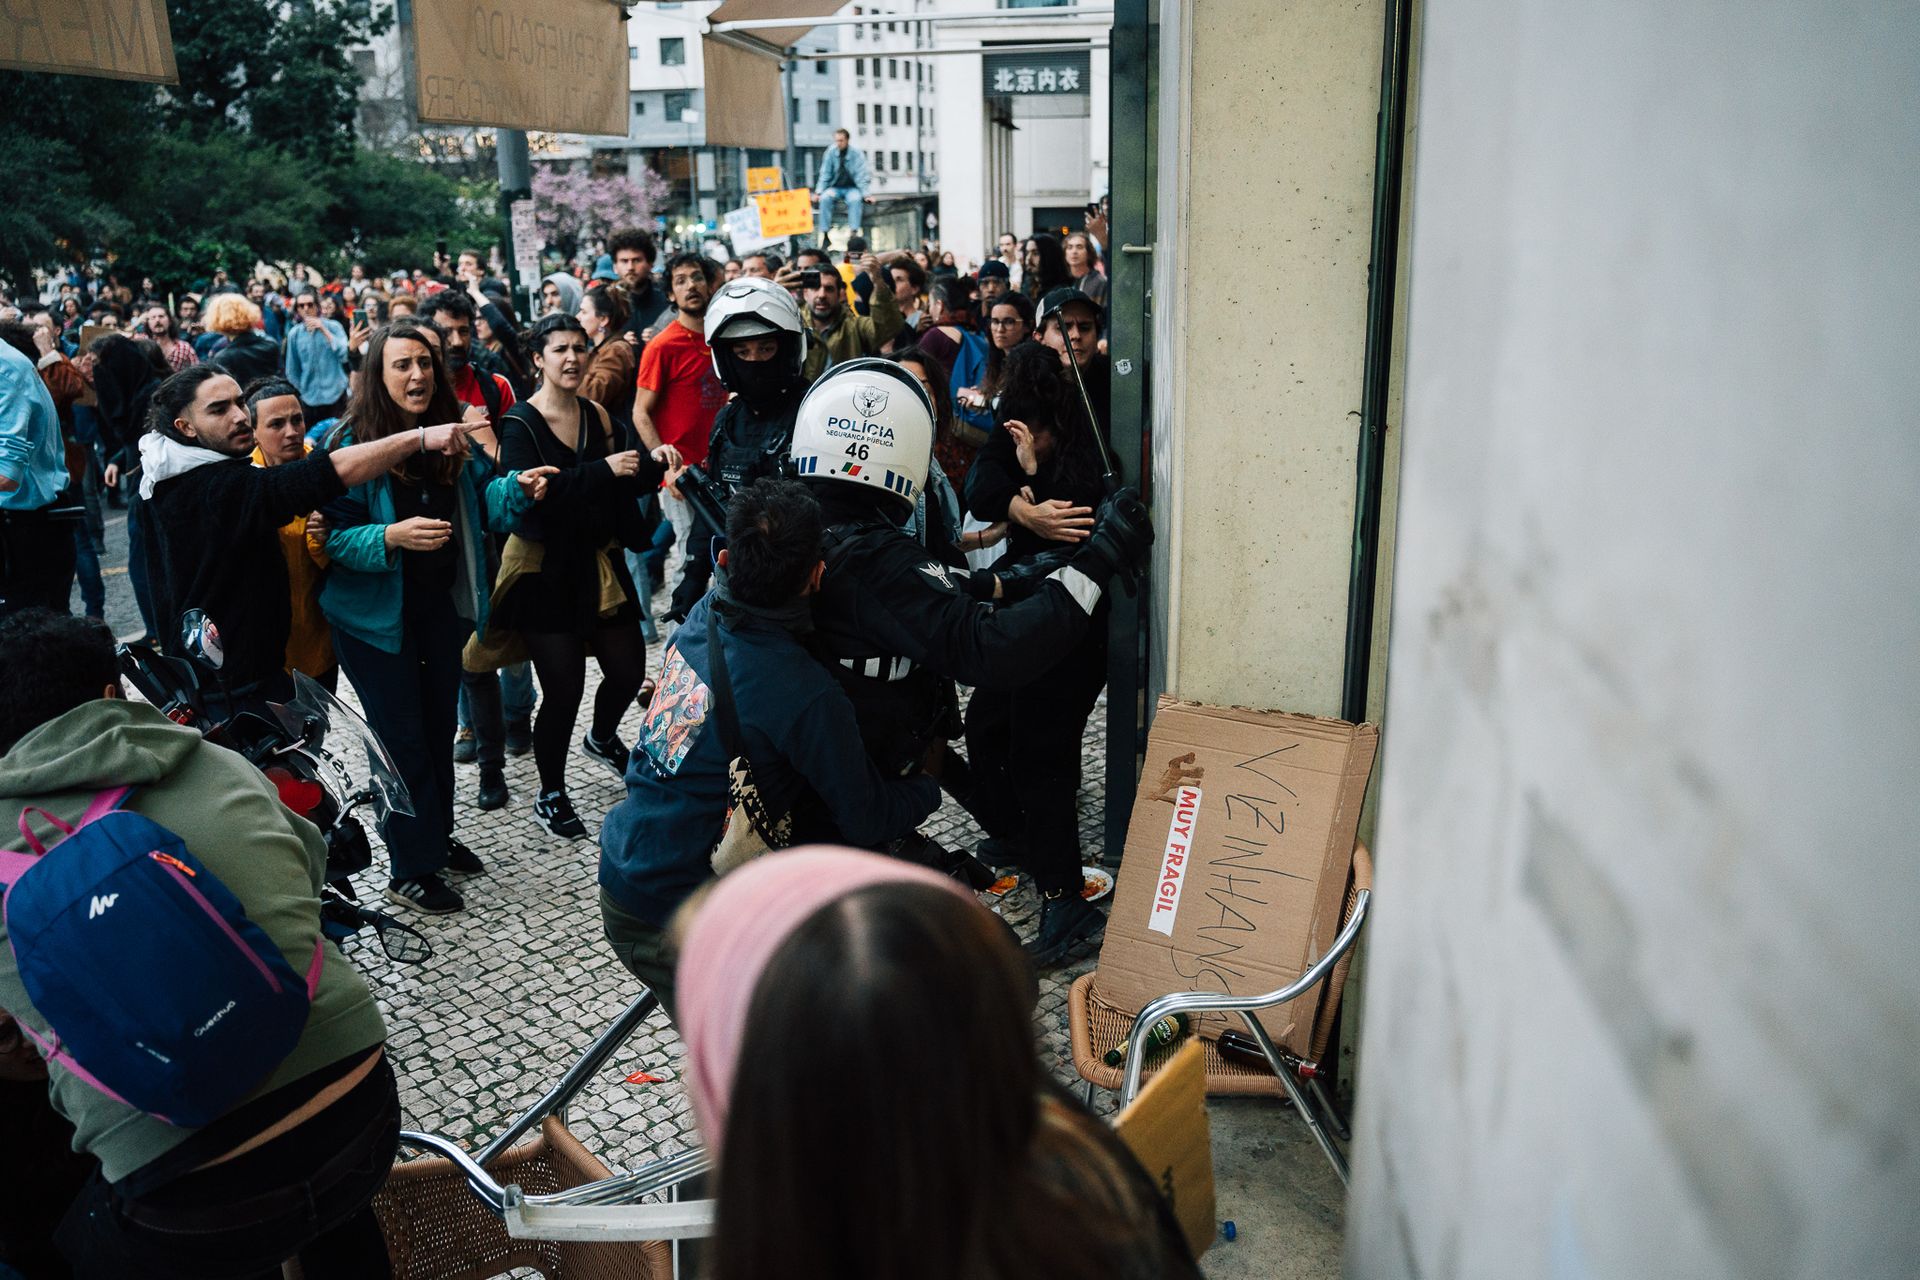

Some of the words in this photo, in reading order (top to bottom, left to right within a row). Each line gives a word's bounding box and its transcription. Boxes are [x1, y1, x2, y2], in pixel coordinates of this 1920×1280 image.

[993, 66, 1080, 92] 北京内衣
[828, 416, 895, 440] POLÍCIA
[845, 442, 870, 461] 46
[1174, 789, 1198, 839] MUY
[1155, 843, 1185, 913] FRAGIL
